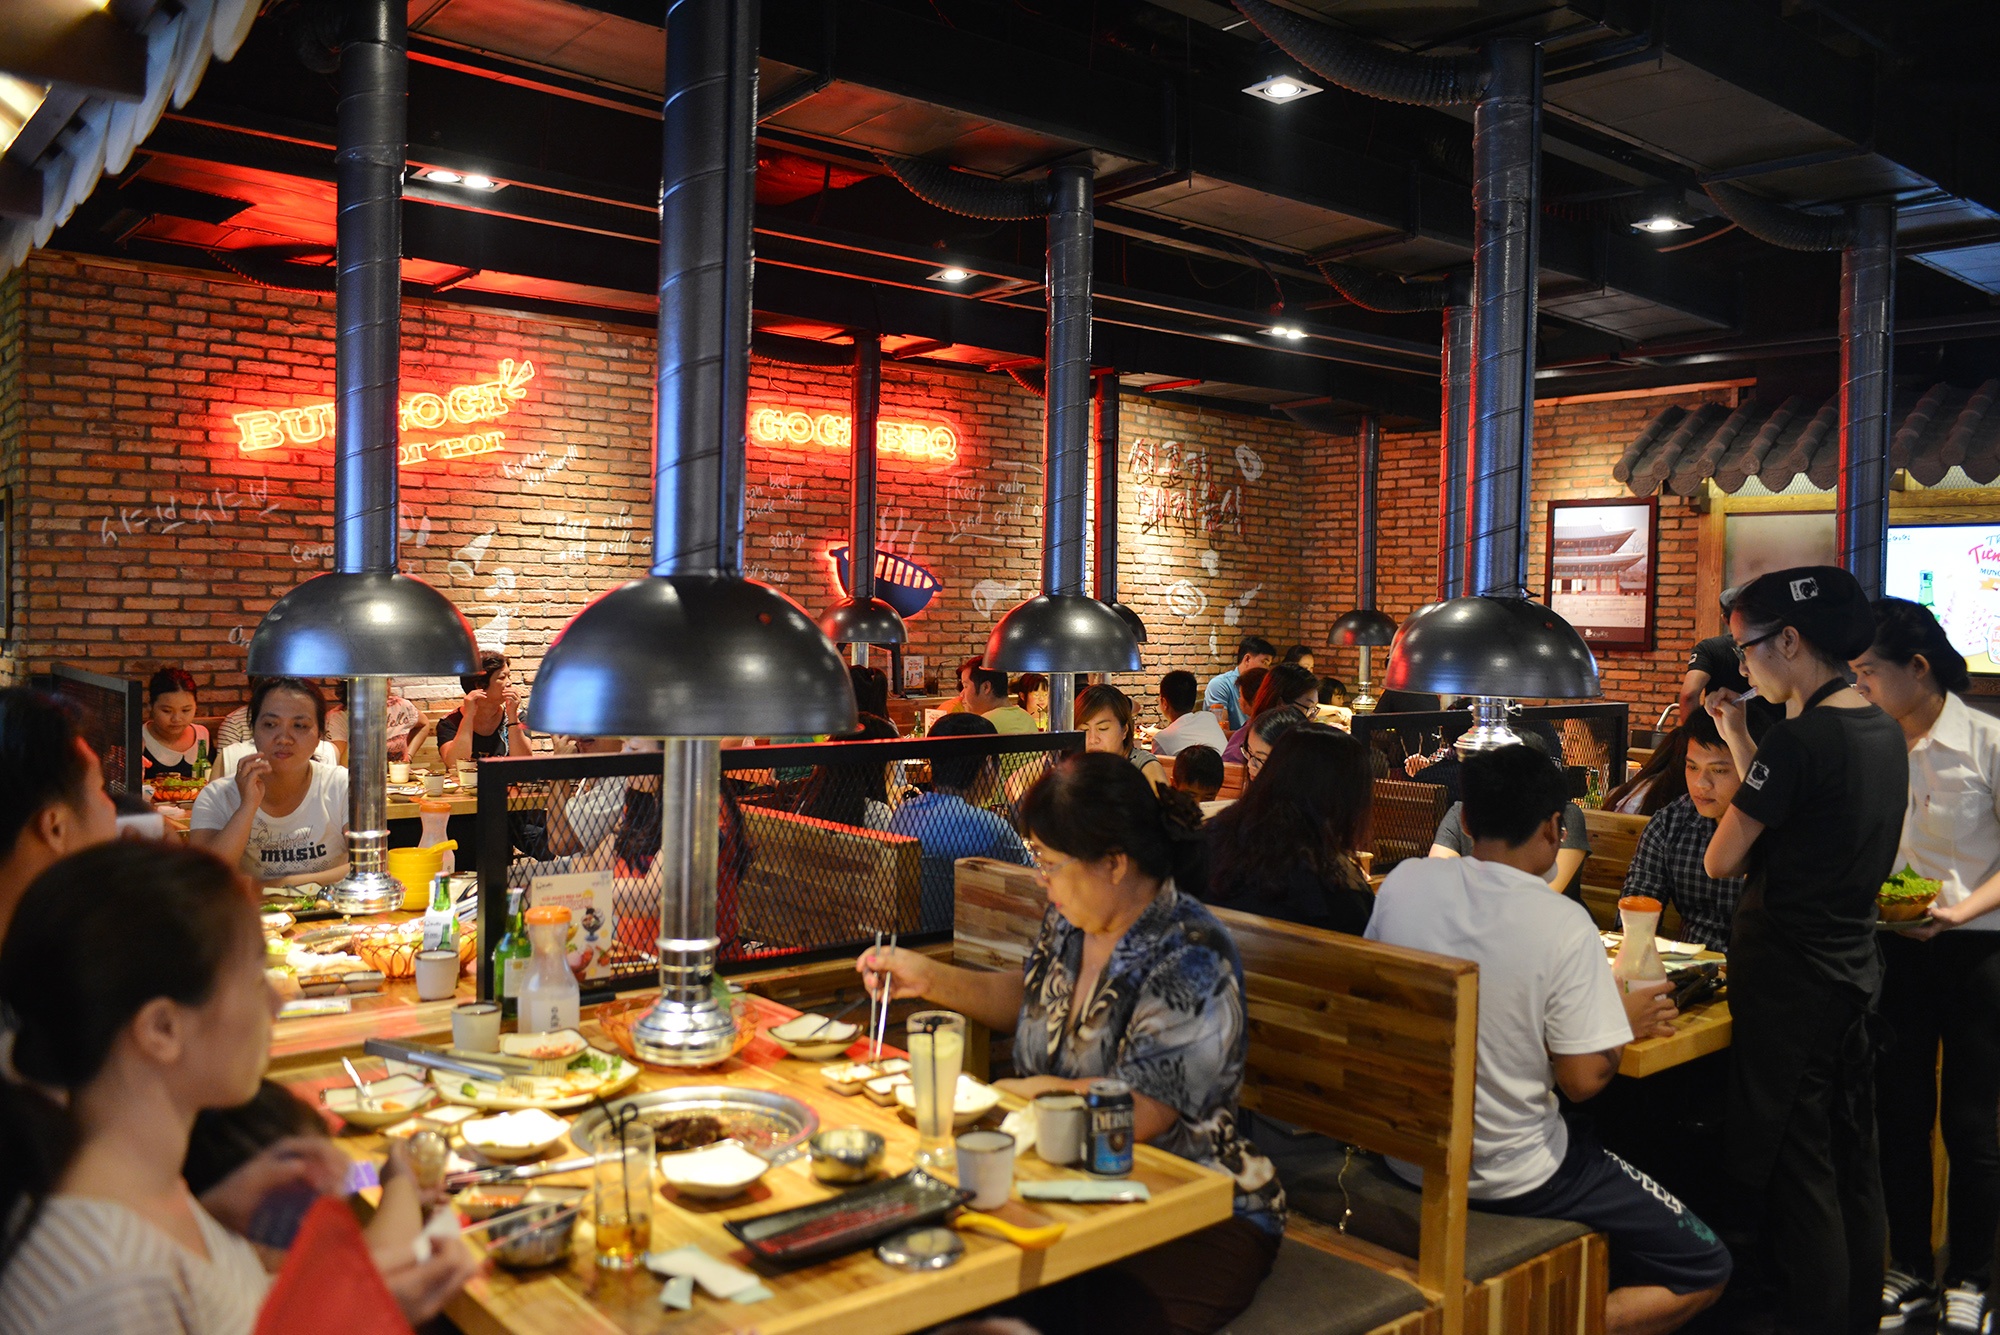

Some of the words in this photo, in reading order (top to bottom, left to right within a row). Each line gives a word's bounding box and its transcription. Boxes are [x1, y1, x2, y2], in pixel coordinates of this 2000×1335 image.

[233, 380, 510, 452] BUOGI
[998, 471, 1026, 496] calm
[291, 545, 335, 563] Carro
[261, 842, 327, 862] music
